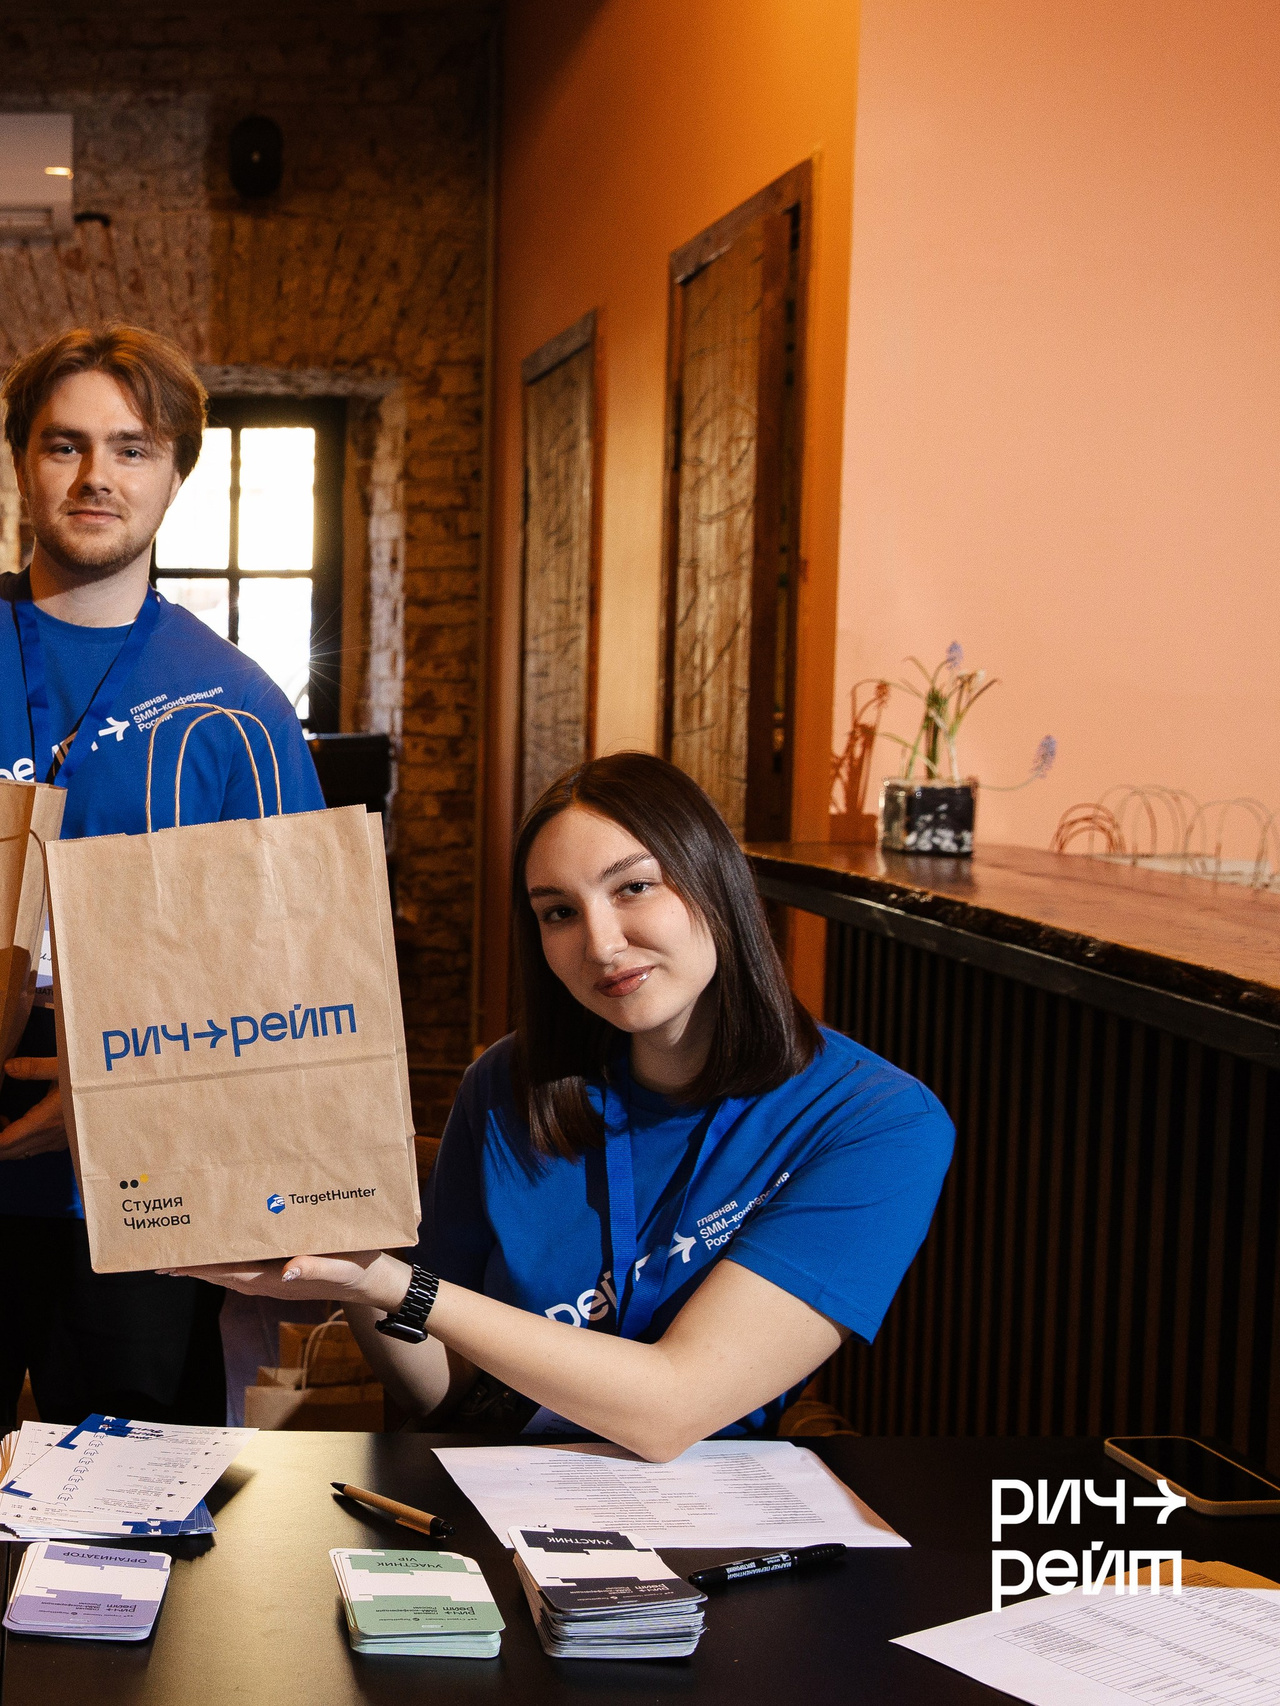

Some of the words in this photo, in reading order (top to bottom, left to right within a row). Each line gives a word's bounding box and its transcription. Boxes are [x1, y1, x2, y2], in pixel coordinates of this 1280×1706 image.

[129, 693, 168, 715] главная
[121, 1196, 183, 1214] Студия
[288, 1187, 377, 1206] TargetHunter
[123, 1214, 191, 1230] Чижова
[696, 1200, 739, 1228] главная
[546, 1536, 613, 1545] УЧАСТНИК
[62, 1550, 148, 1564] ОРГАНИЗАТОР
